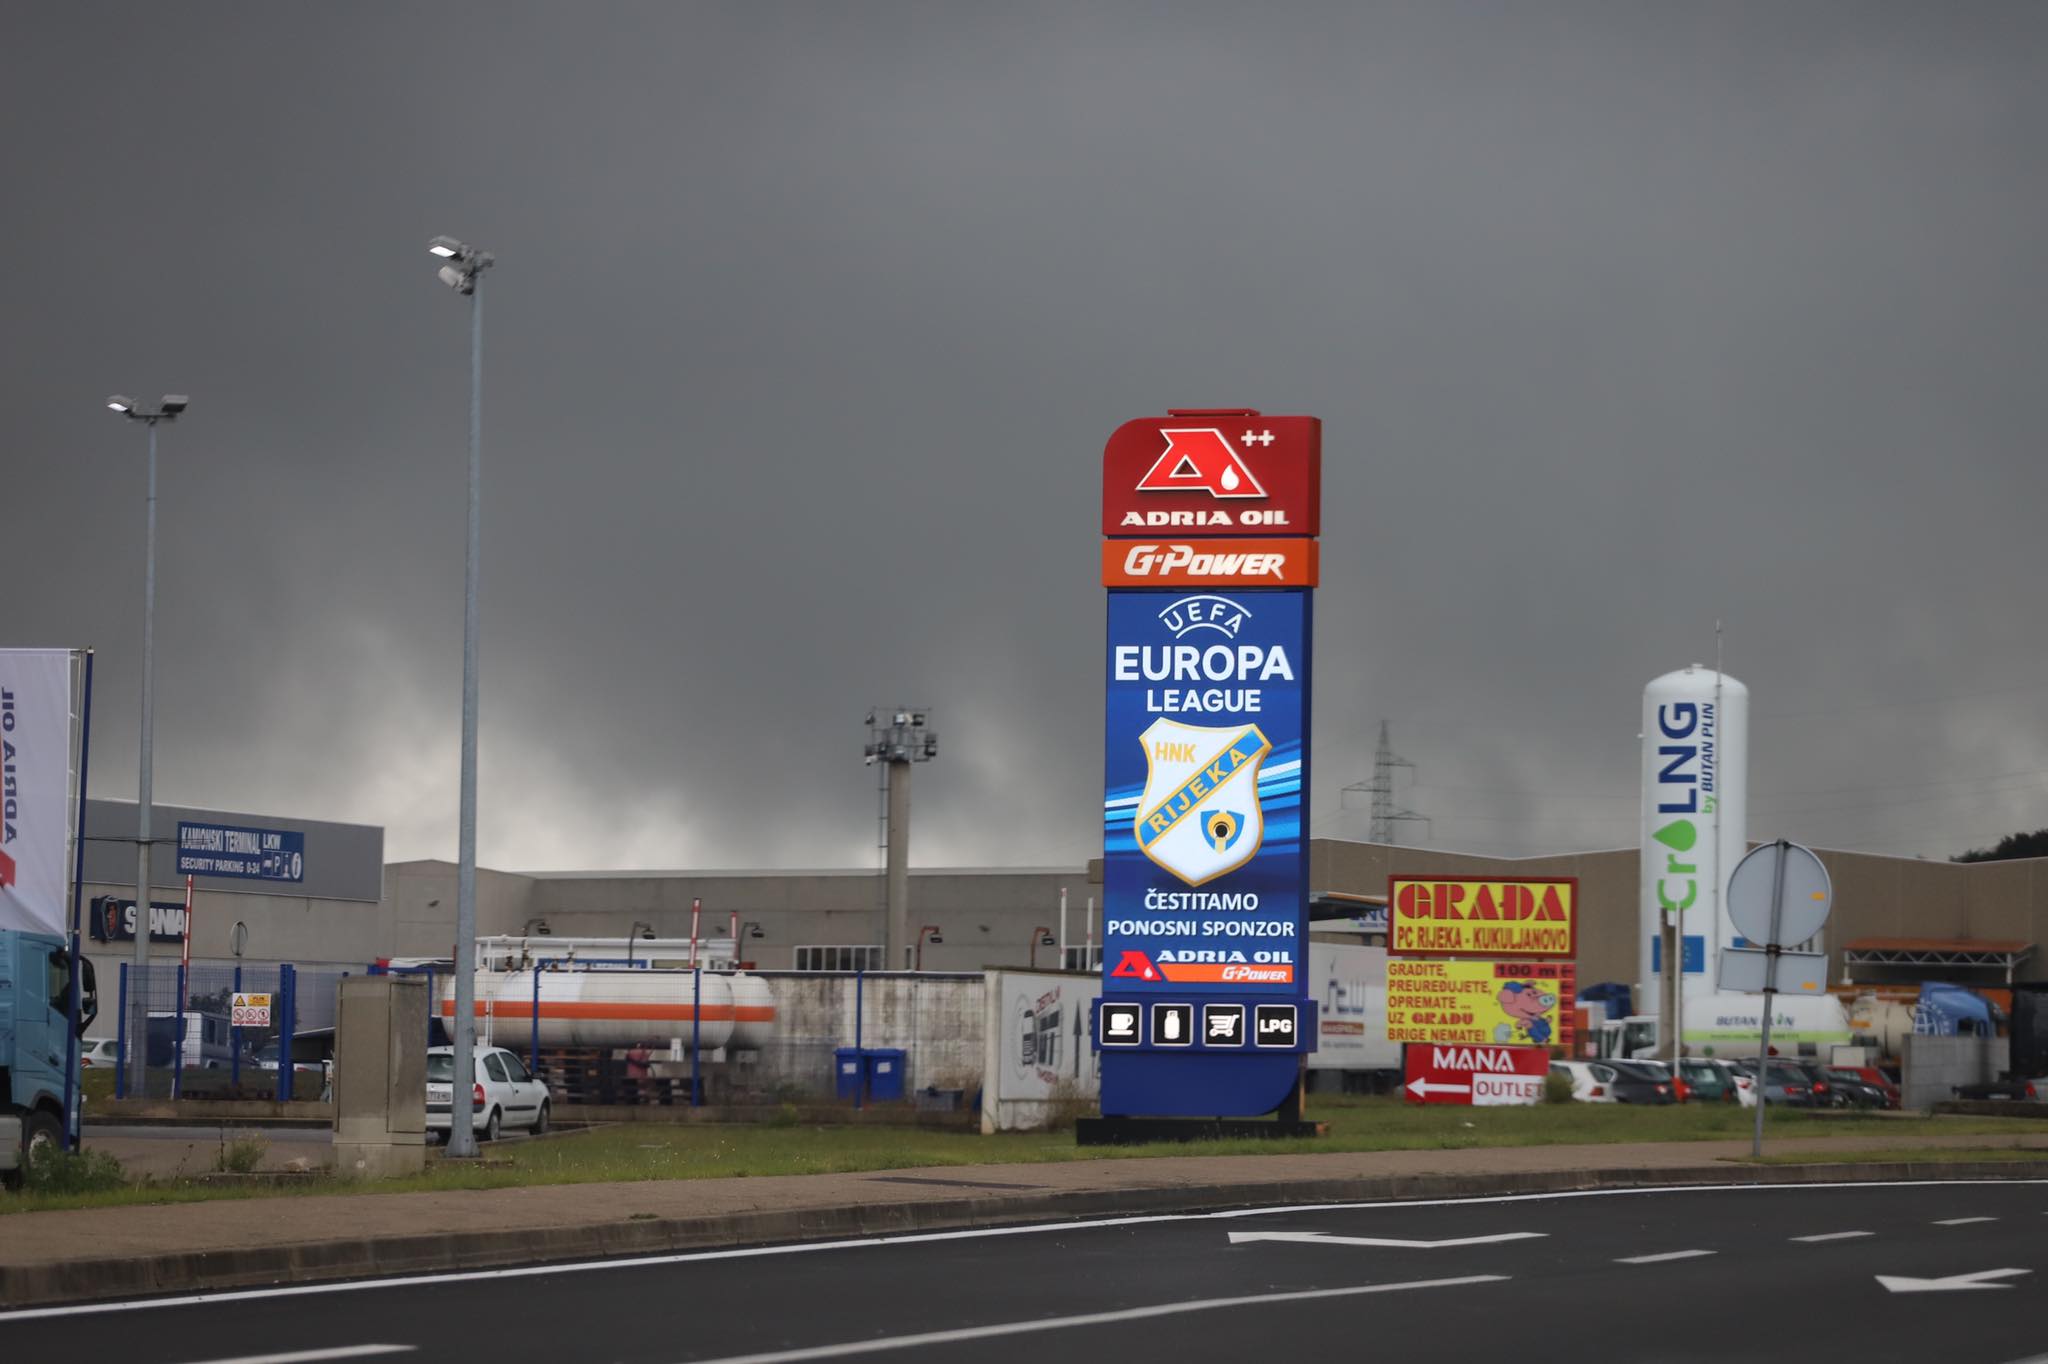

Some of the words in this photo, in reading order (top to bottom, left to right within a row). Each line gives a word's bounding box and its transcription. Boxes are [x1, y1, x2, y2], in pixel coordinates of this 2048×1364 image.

[1120, 511, 1233, 526] ADRIA
[1240, 510, 1290, 525] OIL
[1163, 602, 1243, 633] UEFA
[1115, 645, 1294, 681] EUROPA
[1147, 689, 1261, 712] LEAGUE
[1702, 703, 1715, 738] PLIN
[1155, 742, 1197, 763] HNK
[1702, 742, 1714, 792] BUTAN
[1148, 748, 1248, 833] RIJEKA
[1702, 796, 1717, 814] by
[181, 827, 224, 851] KAMIONSKI
[225, 831, 261, 855] TERMINAL
[263, 833, 281, 849] LKW
[181, 857, 214, 871] SECURITY
[215, 859, 244, 873] PARKING
[1144, 888, 1259, 911] ČESTITAMO
[124, 905, 185, 935] SANIA
[1108, 920, 1197, 936] PONOSNI
[1202, 921, 1295, 937] SPONZOR
[1397, 926, 1413, 948] PC
[1418, 926, 1462, 948] RIJEKA
[1473, 927, 1567, 949] KUKULJANOVO
[1156, 950, 1247, 963] ADRIA
[1253, 951, 1293, 963] OIL
[1388, 963, 1447, 978] GRADITE,
[1496, 964, 1531, 976] 100
[1539, 967, 1556, 976] m
[1388, 996, 1456, 1008] OPREMATE
[1260, 1019, 1292, 1033] LPG
[1388, 1012, 1405, 1024] UZ
[1716, 1016, 1757, 1026] BUTAN
[1388, 1028, 1426, 1040] BRIGE
[1430, 1029, 1485, 1041] NEMATE!
[1433, 1047, 1515, 1072] MANA
